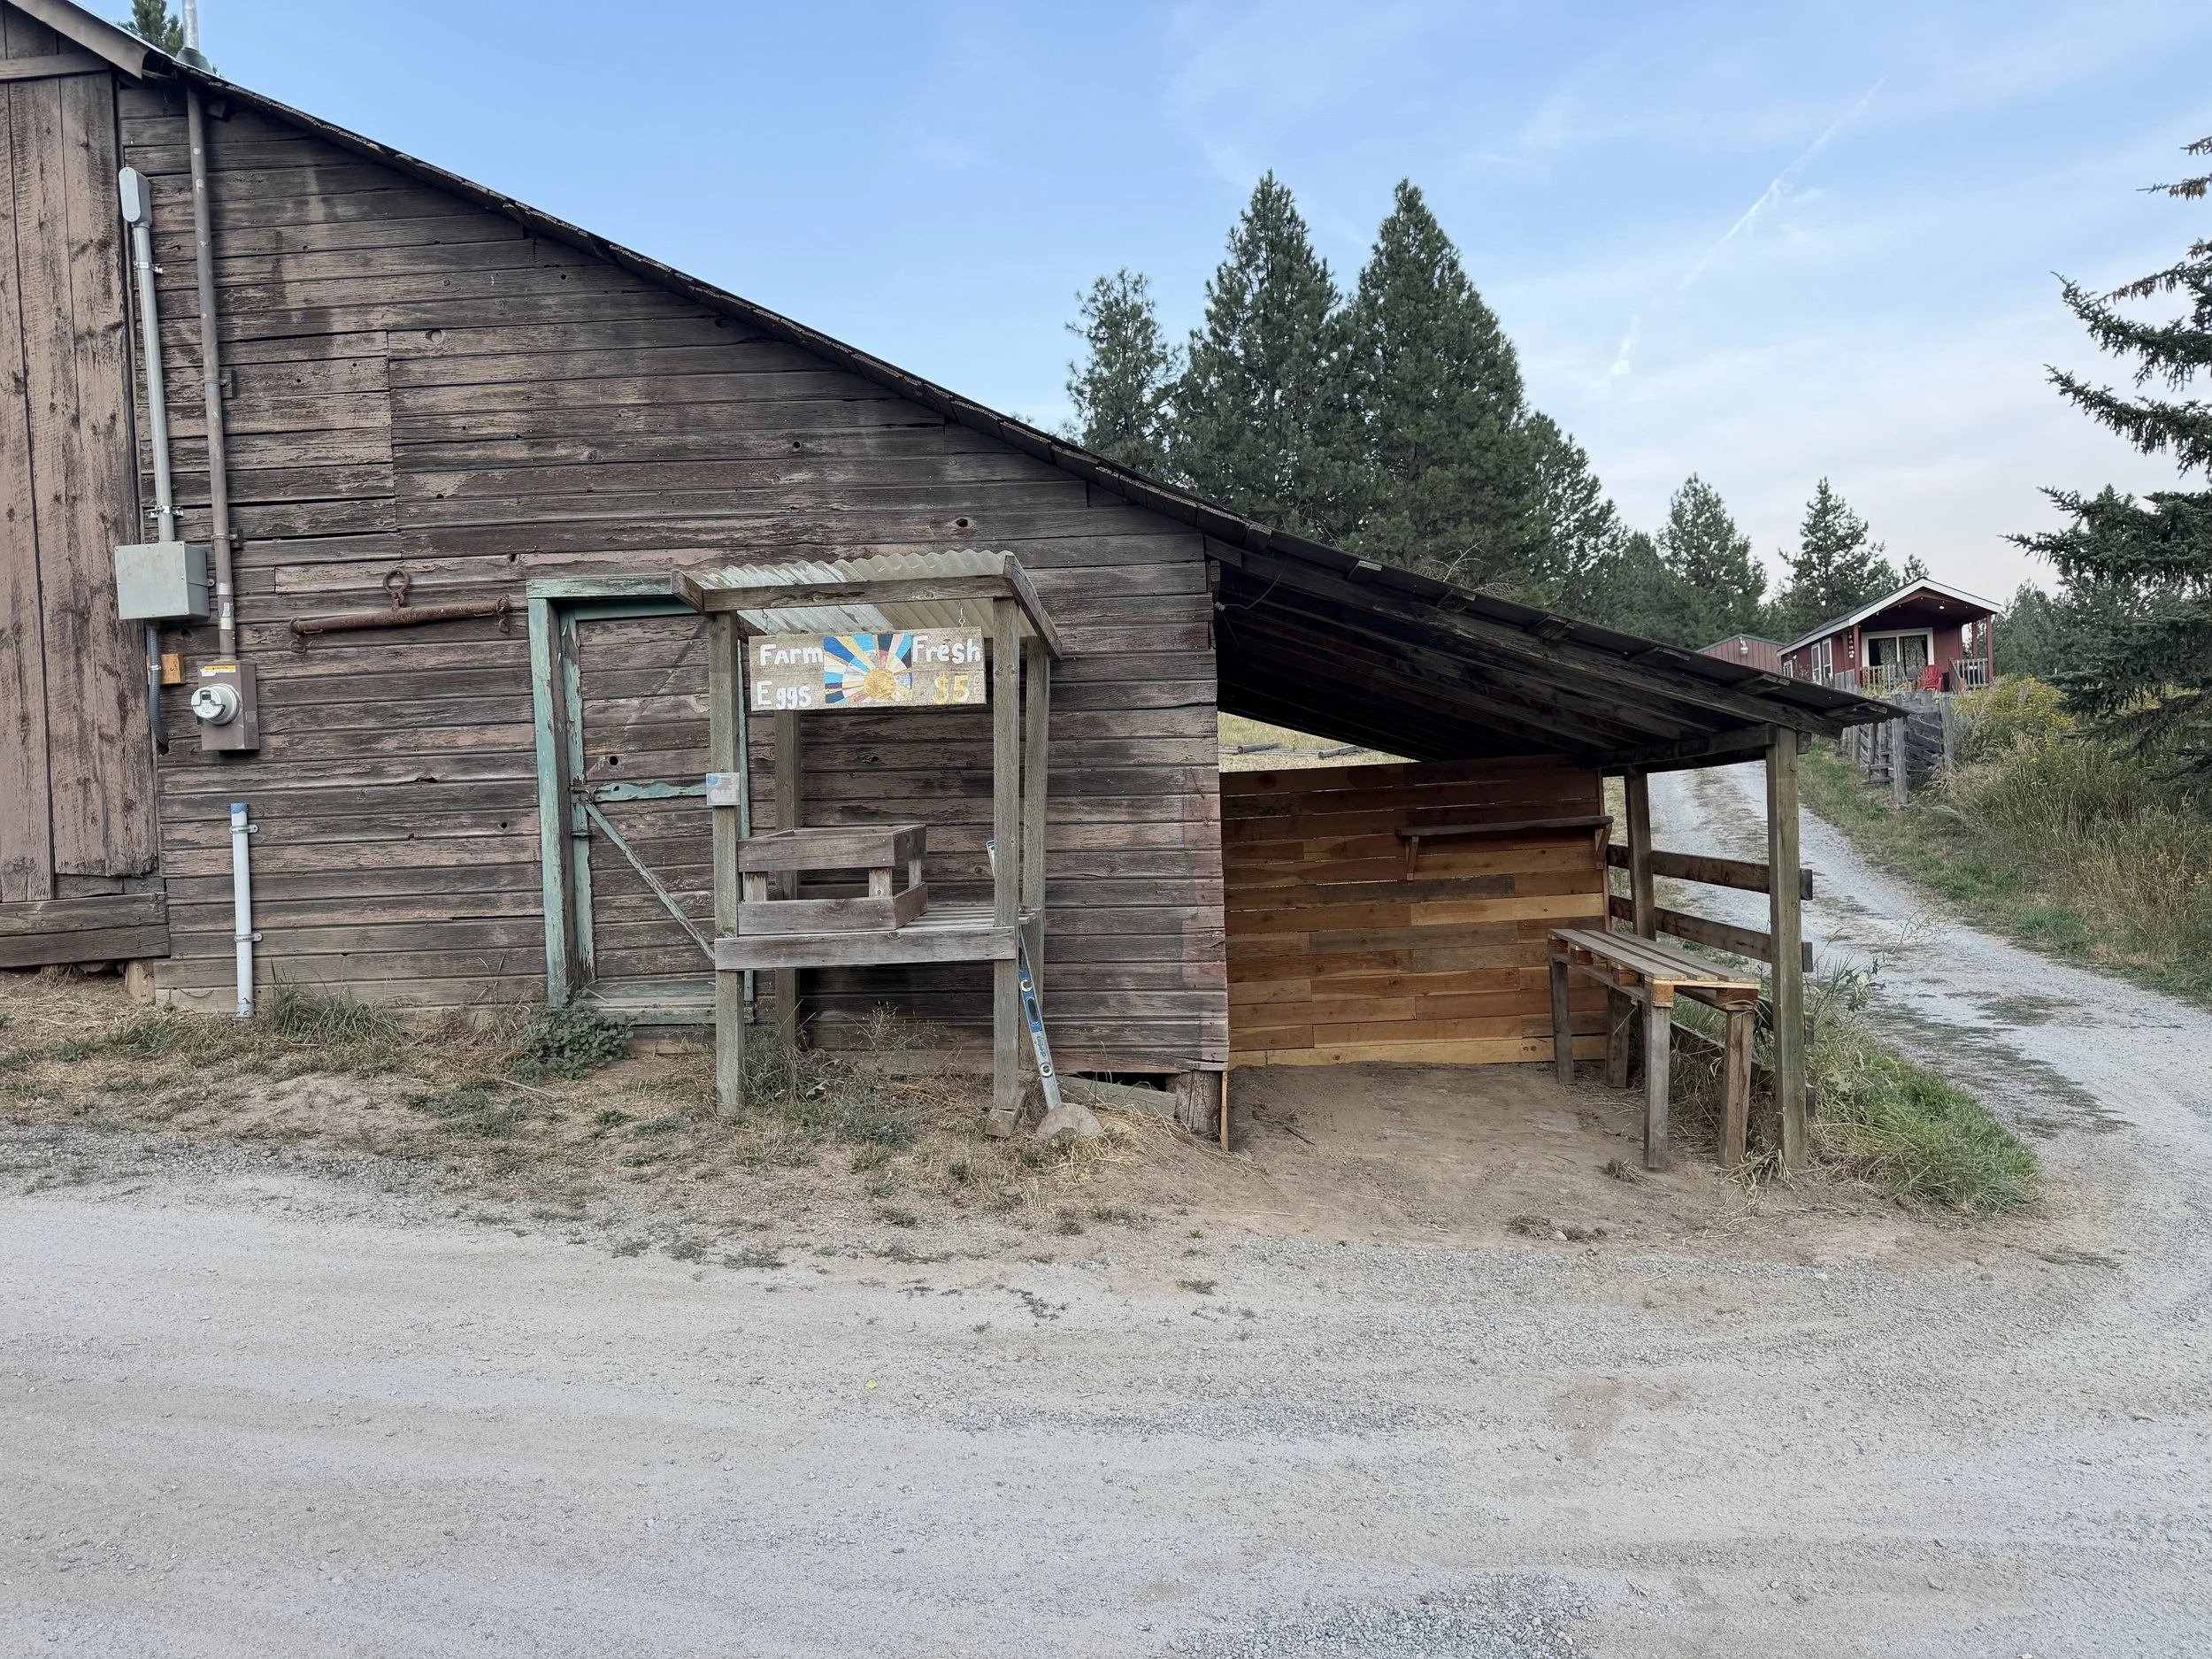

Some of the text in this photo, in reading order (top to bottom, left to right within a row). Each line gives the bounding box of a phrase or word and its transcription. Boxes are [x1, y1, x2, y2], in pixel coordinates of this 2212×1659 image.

[760, 635, 981, 666] Farm Fresh
[757, 672, 970, 710] Eggs $5
